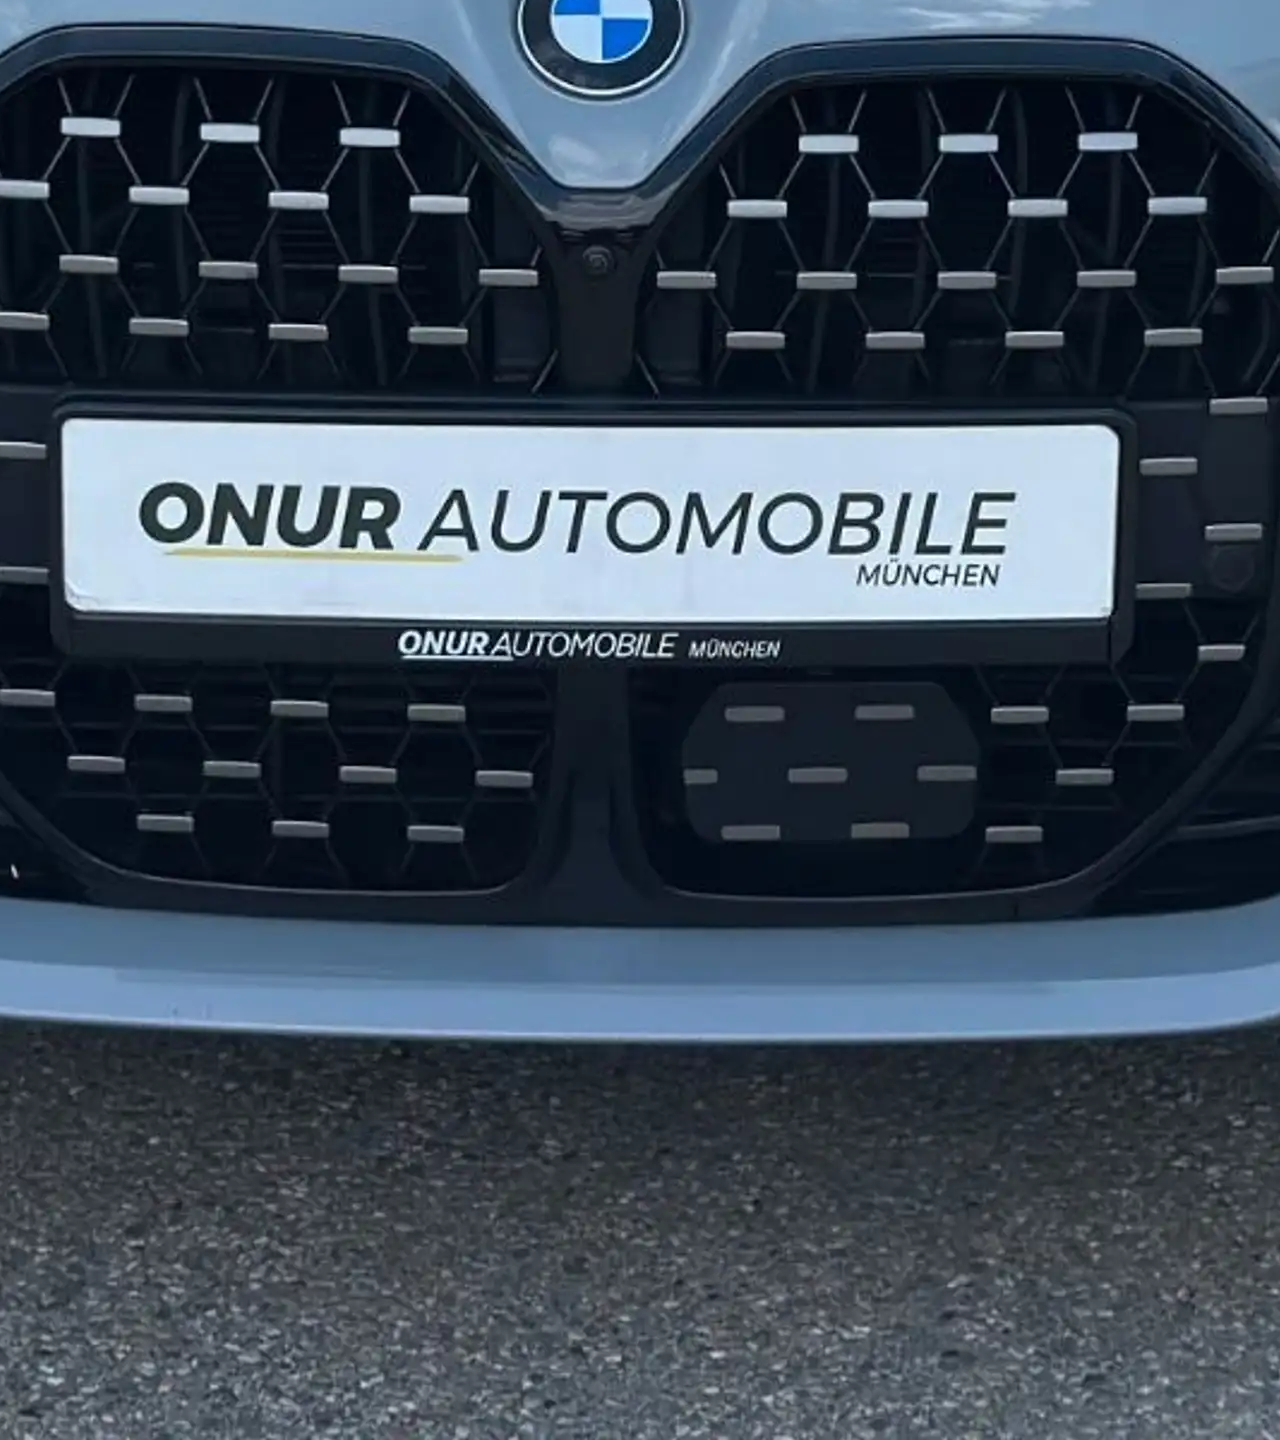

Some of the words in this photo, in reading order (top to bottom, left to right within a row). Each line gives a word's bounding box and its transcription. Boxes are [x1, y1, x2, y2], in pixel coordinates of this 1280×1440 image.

[138, 482, 402, 549] ONUR
[417, 489, 1017, 556] AUTOMOBILE
[856, 560, 1001, 587] MÜNCHEN
[397, 630, 490, 656] ONUR
[489, 632, 679, 659] AUTOMOBILE
[688, 638, 781, 659] MÜNCHEN
